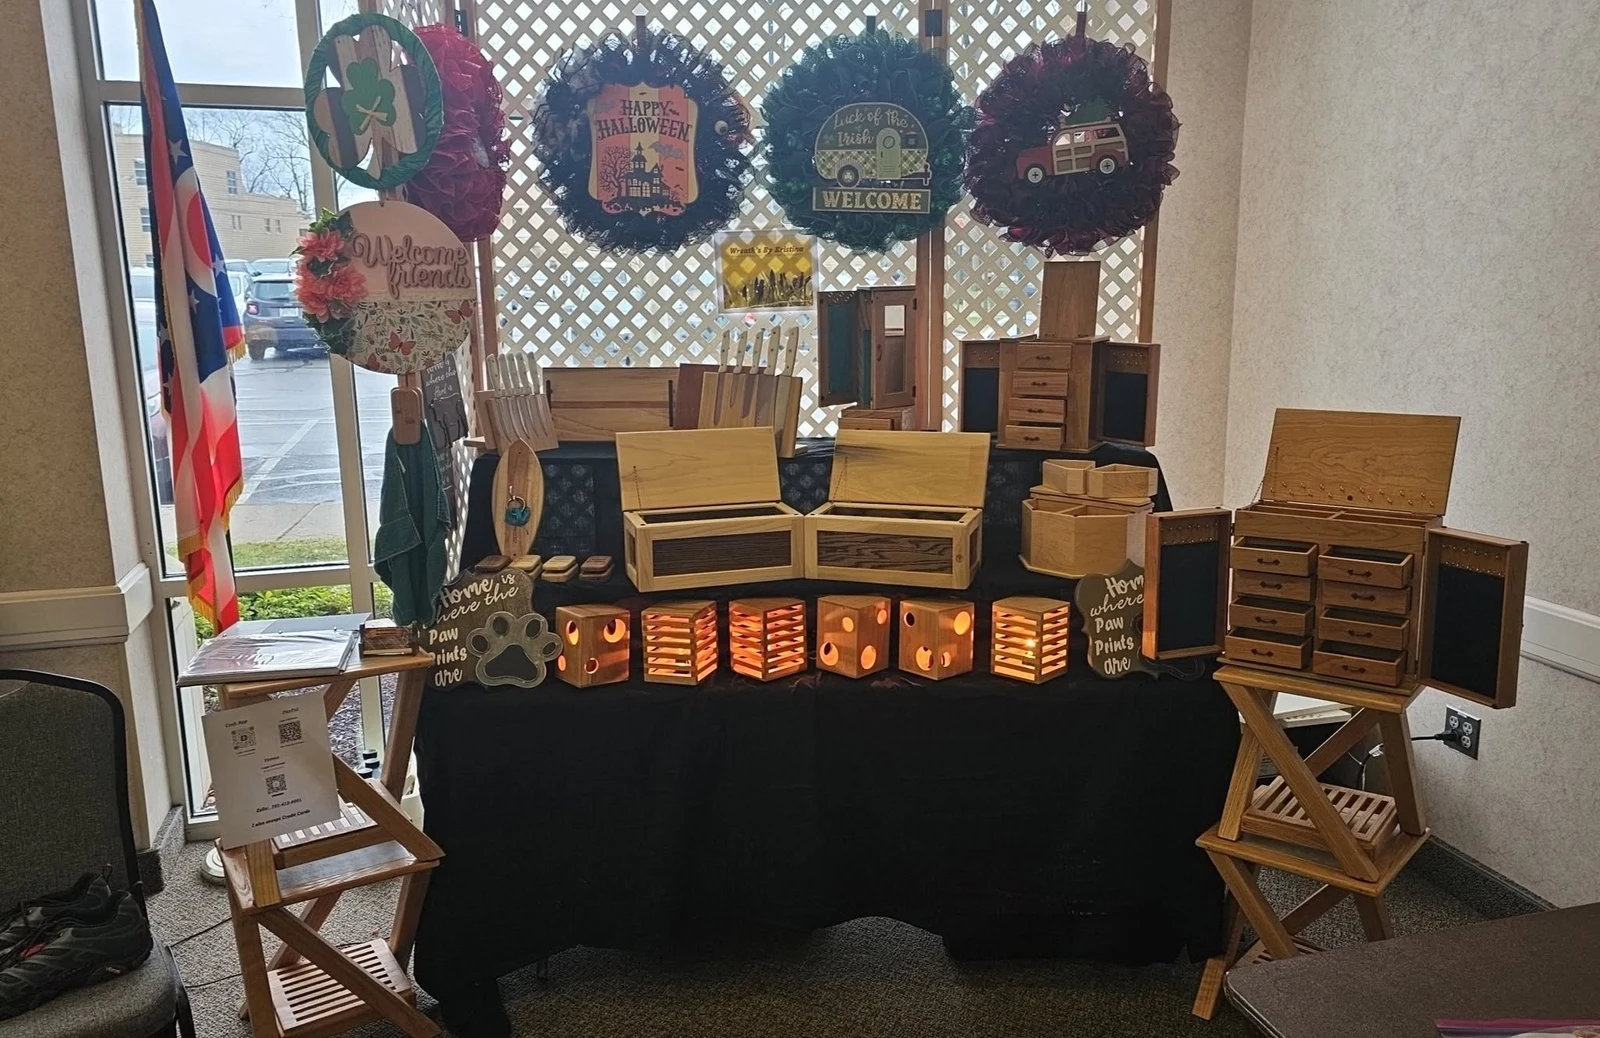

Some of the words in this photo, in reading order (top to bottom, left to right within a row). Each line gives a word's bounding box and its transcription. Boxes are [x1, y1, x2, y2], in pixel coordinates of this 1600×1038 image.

[620, 100, 673, 116] HAPPY
[833, 109, 865, 129] Luck
[867, 107, 882, 126] of
[595, 116, 693, 142] HALLOWEEN
[837, 129, 874, 146] Irish
[822, 190, 921, 210] WELCOME
[353, 233, 468, 268] Welcome
[729, 246, 761, 254] Wreath's
[763, 246, 773, 255] By
[774, 245, 804, 253] Kristina
[387, 261, 471, 299] friends
[440, 578, 493, 608] Home
[501, 573, 516, 585] is
[484, 583, 519, 605] the
[1105, 575, 1144, 598] Hom
[1090, 594, 1144, 617] where
[1094, 616, 1124, 633] Paw
[429, 627, 459, 645] Paw
[1094, 634, 1134, 656] Prints
[1104, 657, 1131, 675] are
[435, 668, 463, 687] are
